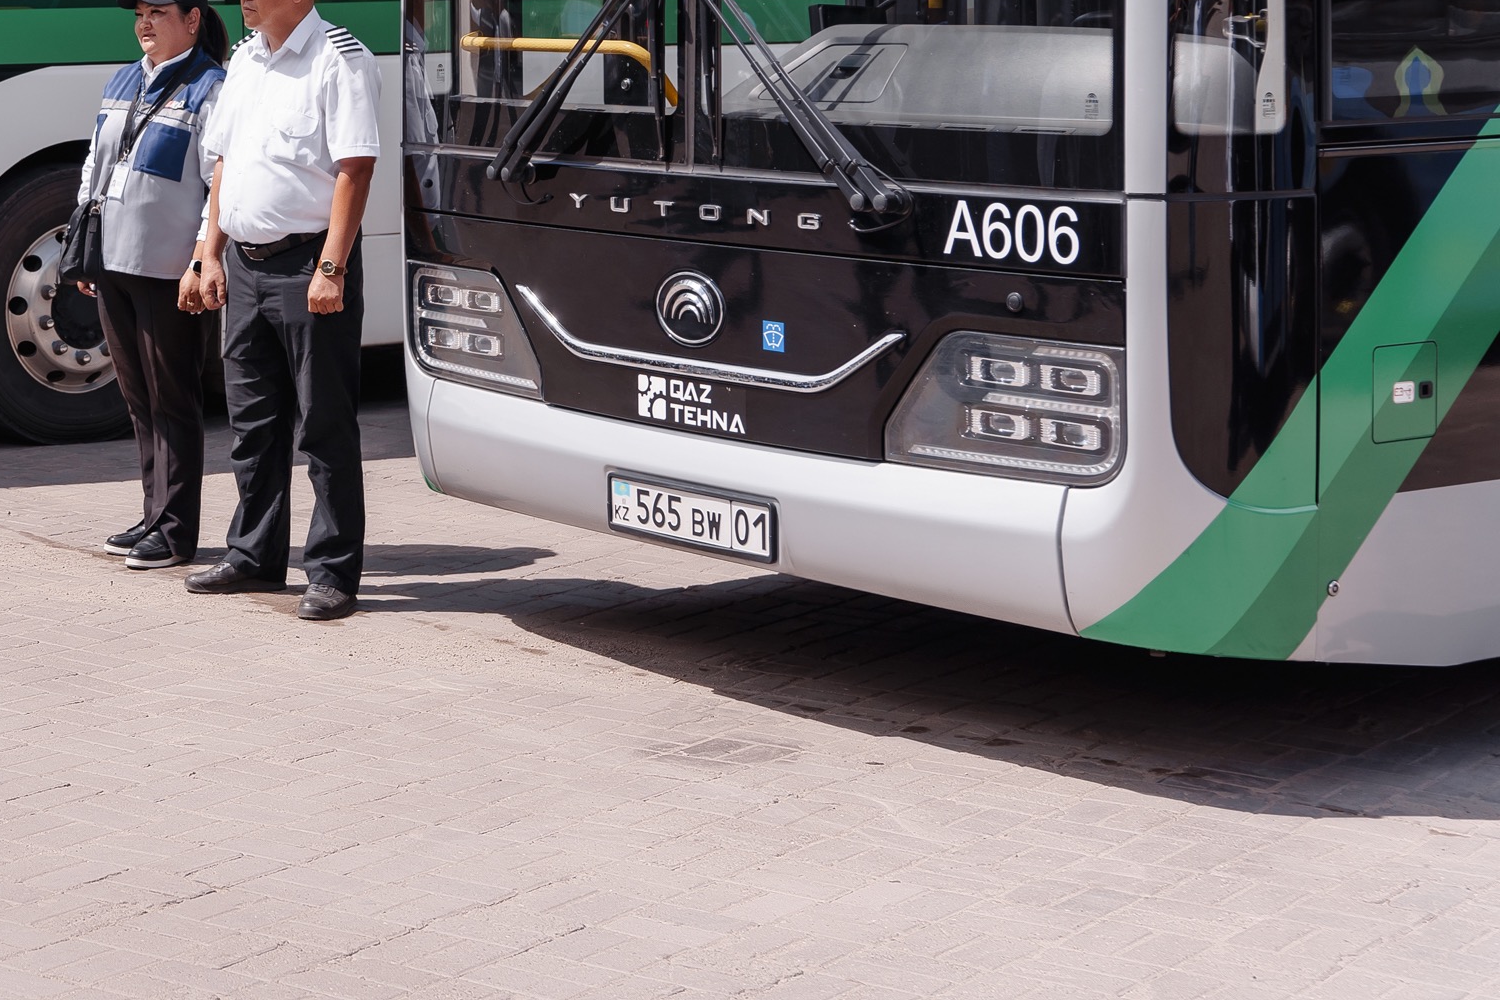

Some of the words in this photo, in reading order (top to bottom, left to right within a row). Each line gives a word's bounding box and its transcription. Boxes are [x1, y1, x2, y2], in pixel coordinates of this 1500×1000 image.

[569, 192, 823, 230] YUTONG
[943, 199, 1080, 265] A606
[670, 379, 712, 404] QAZ
[670, 403, 746, 434] TEHNA
[614, 504, 630, 522] KZ
[636, 488, 681, 531] 565
[691, 507, 721, 541] BW
[734, 508, 766, 550] 01
